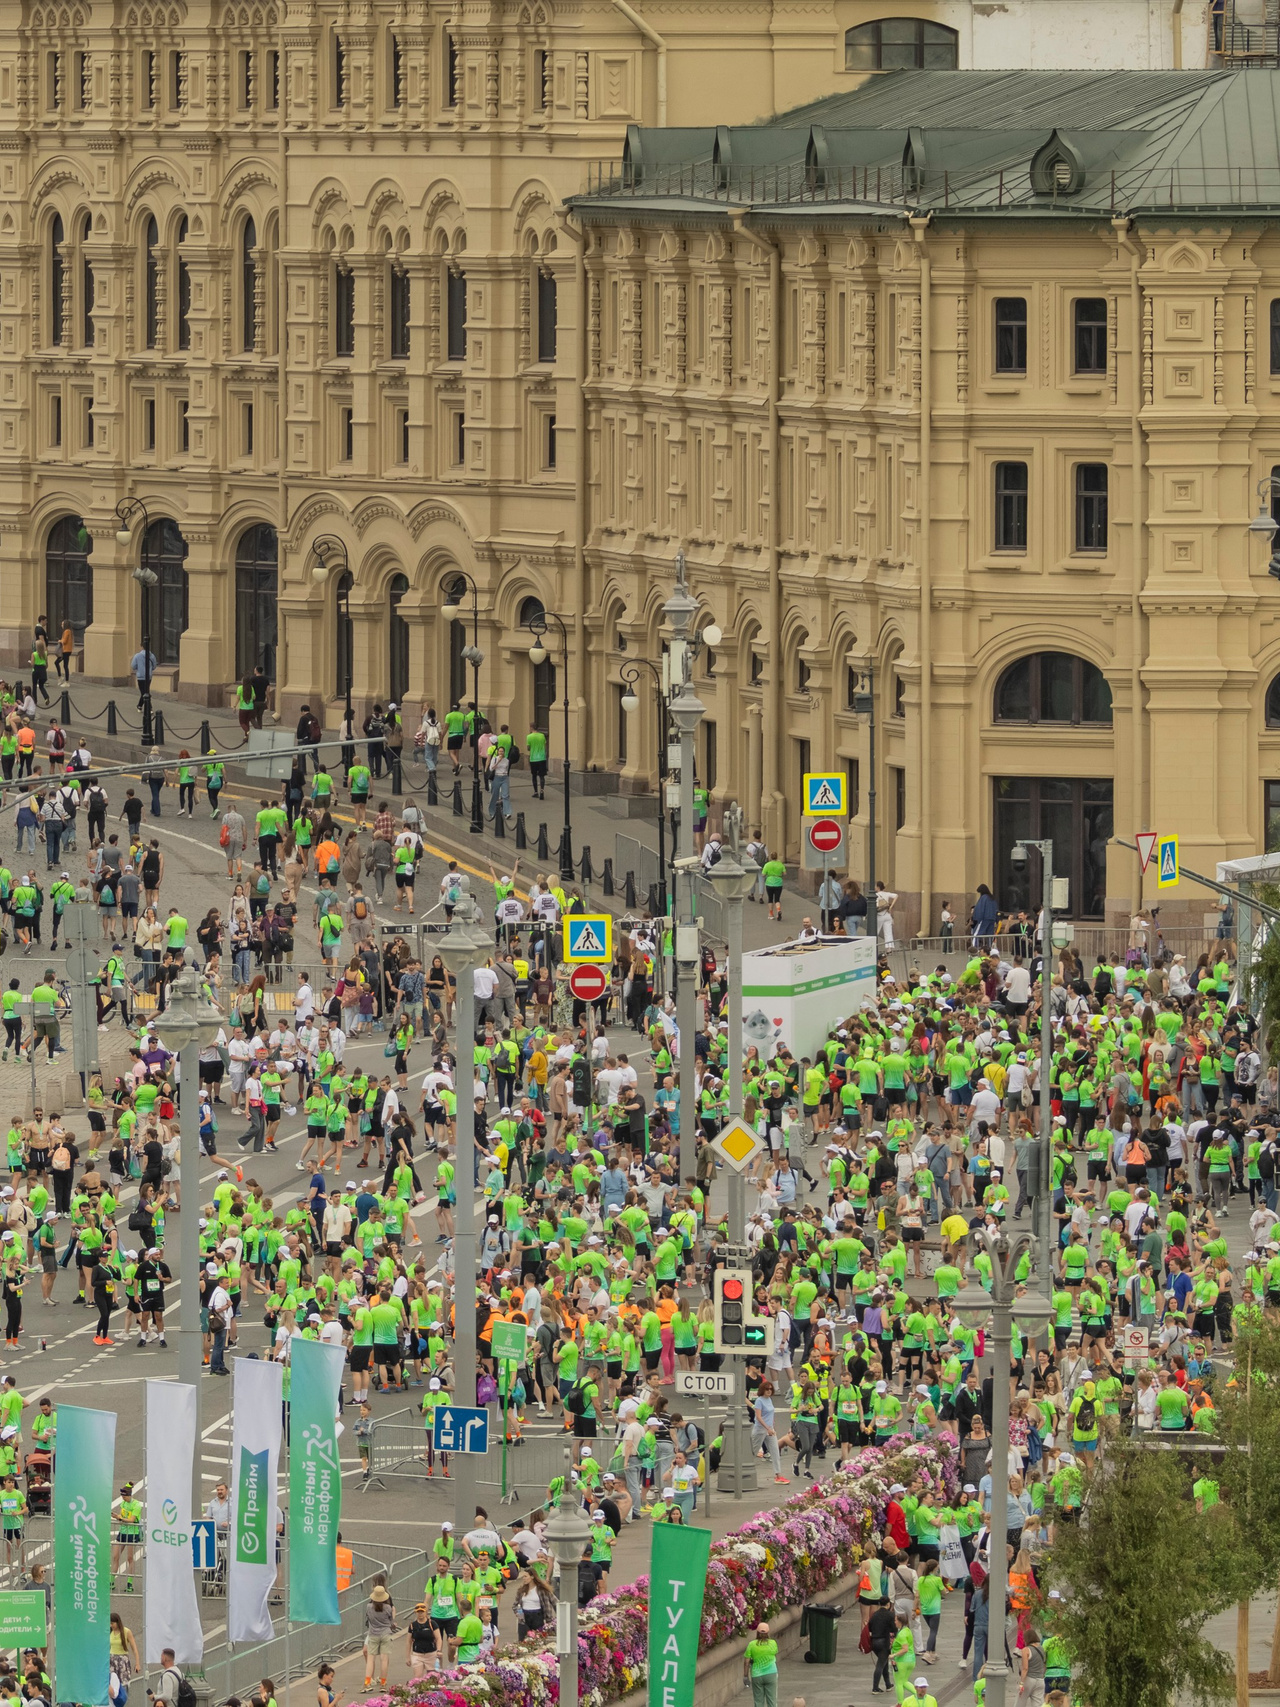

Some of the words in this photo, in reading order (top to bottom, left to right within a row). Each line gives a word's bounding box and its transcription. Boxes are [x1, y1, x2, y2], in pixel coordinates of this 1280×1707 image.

[684, 1376, 726, 1390] СТОП
[244, 1464, 259, 1527] Прайм
[301, 1461, 316, 1534] зелёный
[316, 1469, 333, 1545] марафон
[70, 1534, 83, 1610] зелёный
[152, 1529, 188, 1546] СБЕР
[84, 1544, 99, 1623] марафон
